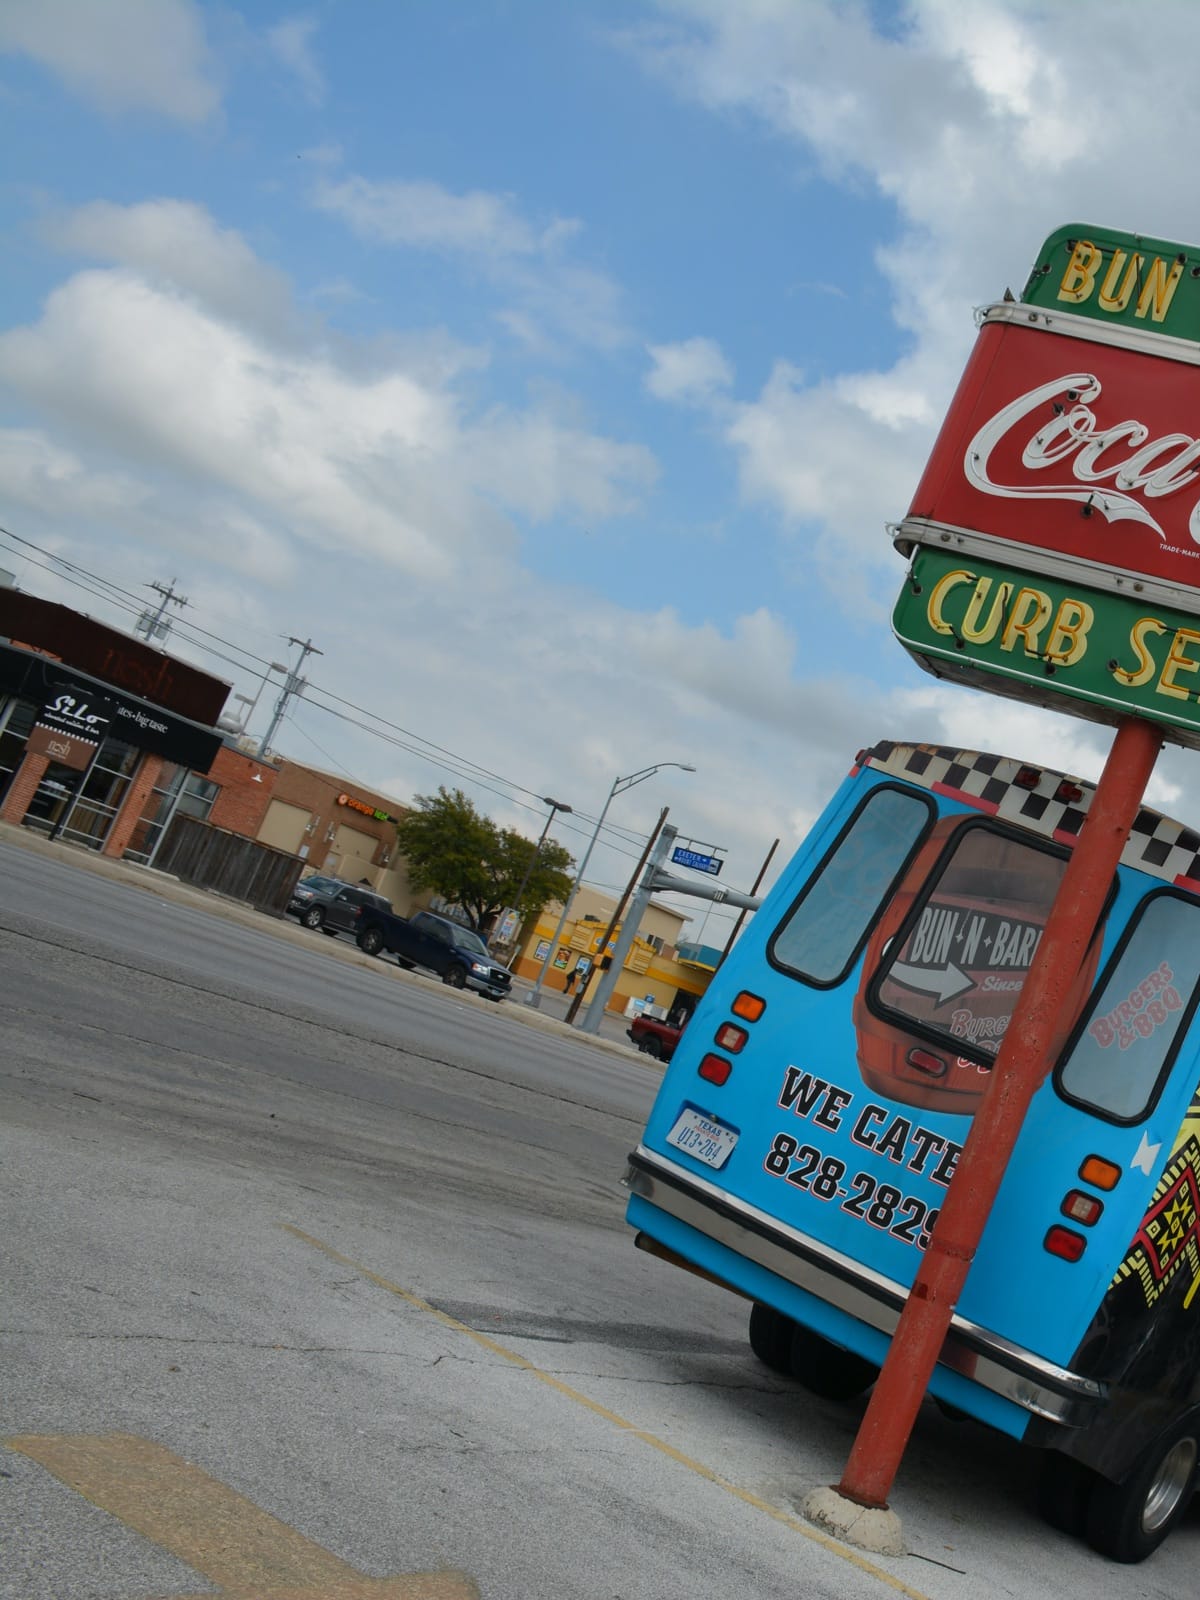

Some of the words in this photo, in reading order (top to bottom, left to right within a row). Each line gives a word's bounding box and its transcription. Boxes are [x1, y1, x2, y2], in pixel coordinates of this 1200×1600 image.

[1057, 240, 1184, 323] BUN
[927, 569, 1095, 667] CURB
[910, 906, 960, 964] BUN
[960, 915, 987, 965] N
[988, 921, 1044, 967] BAR
[981, 975, 1024, 993] Since
[1088, 960, 1175, 1049] BURGERS
[950, 1008, 1011, 1038] BURG
[699, 1120, 722, 1137] TEXAS
[777, 1065, 854, 1133] WE
